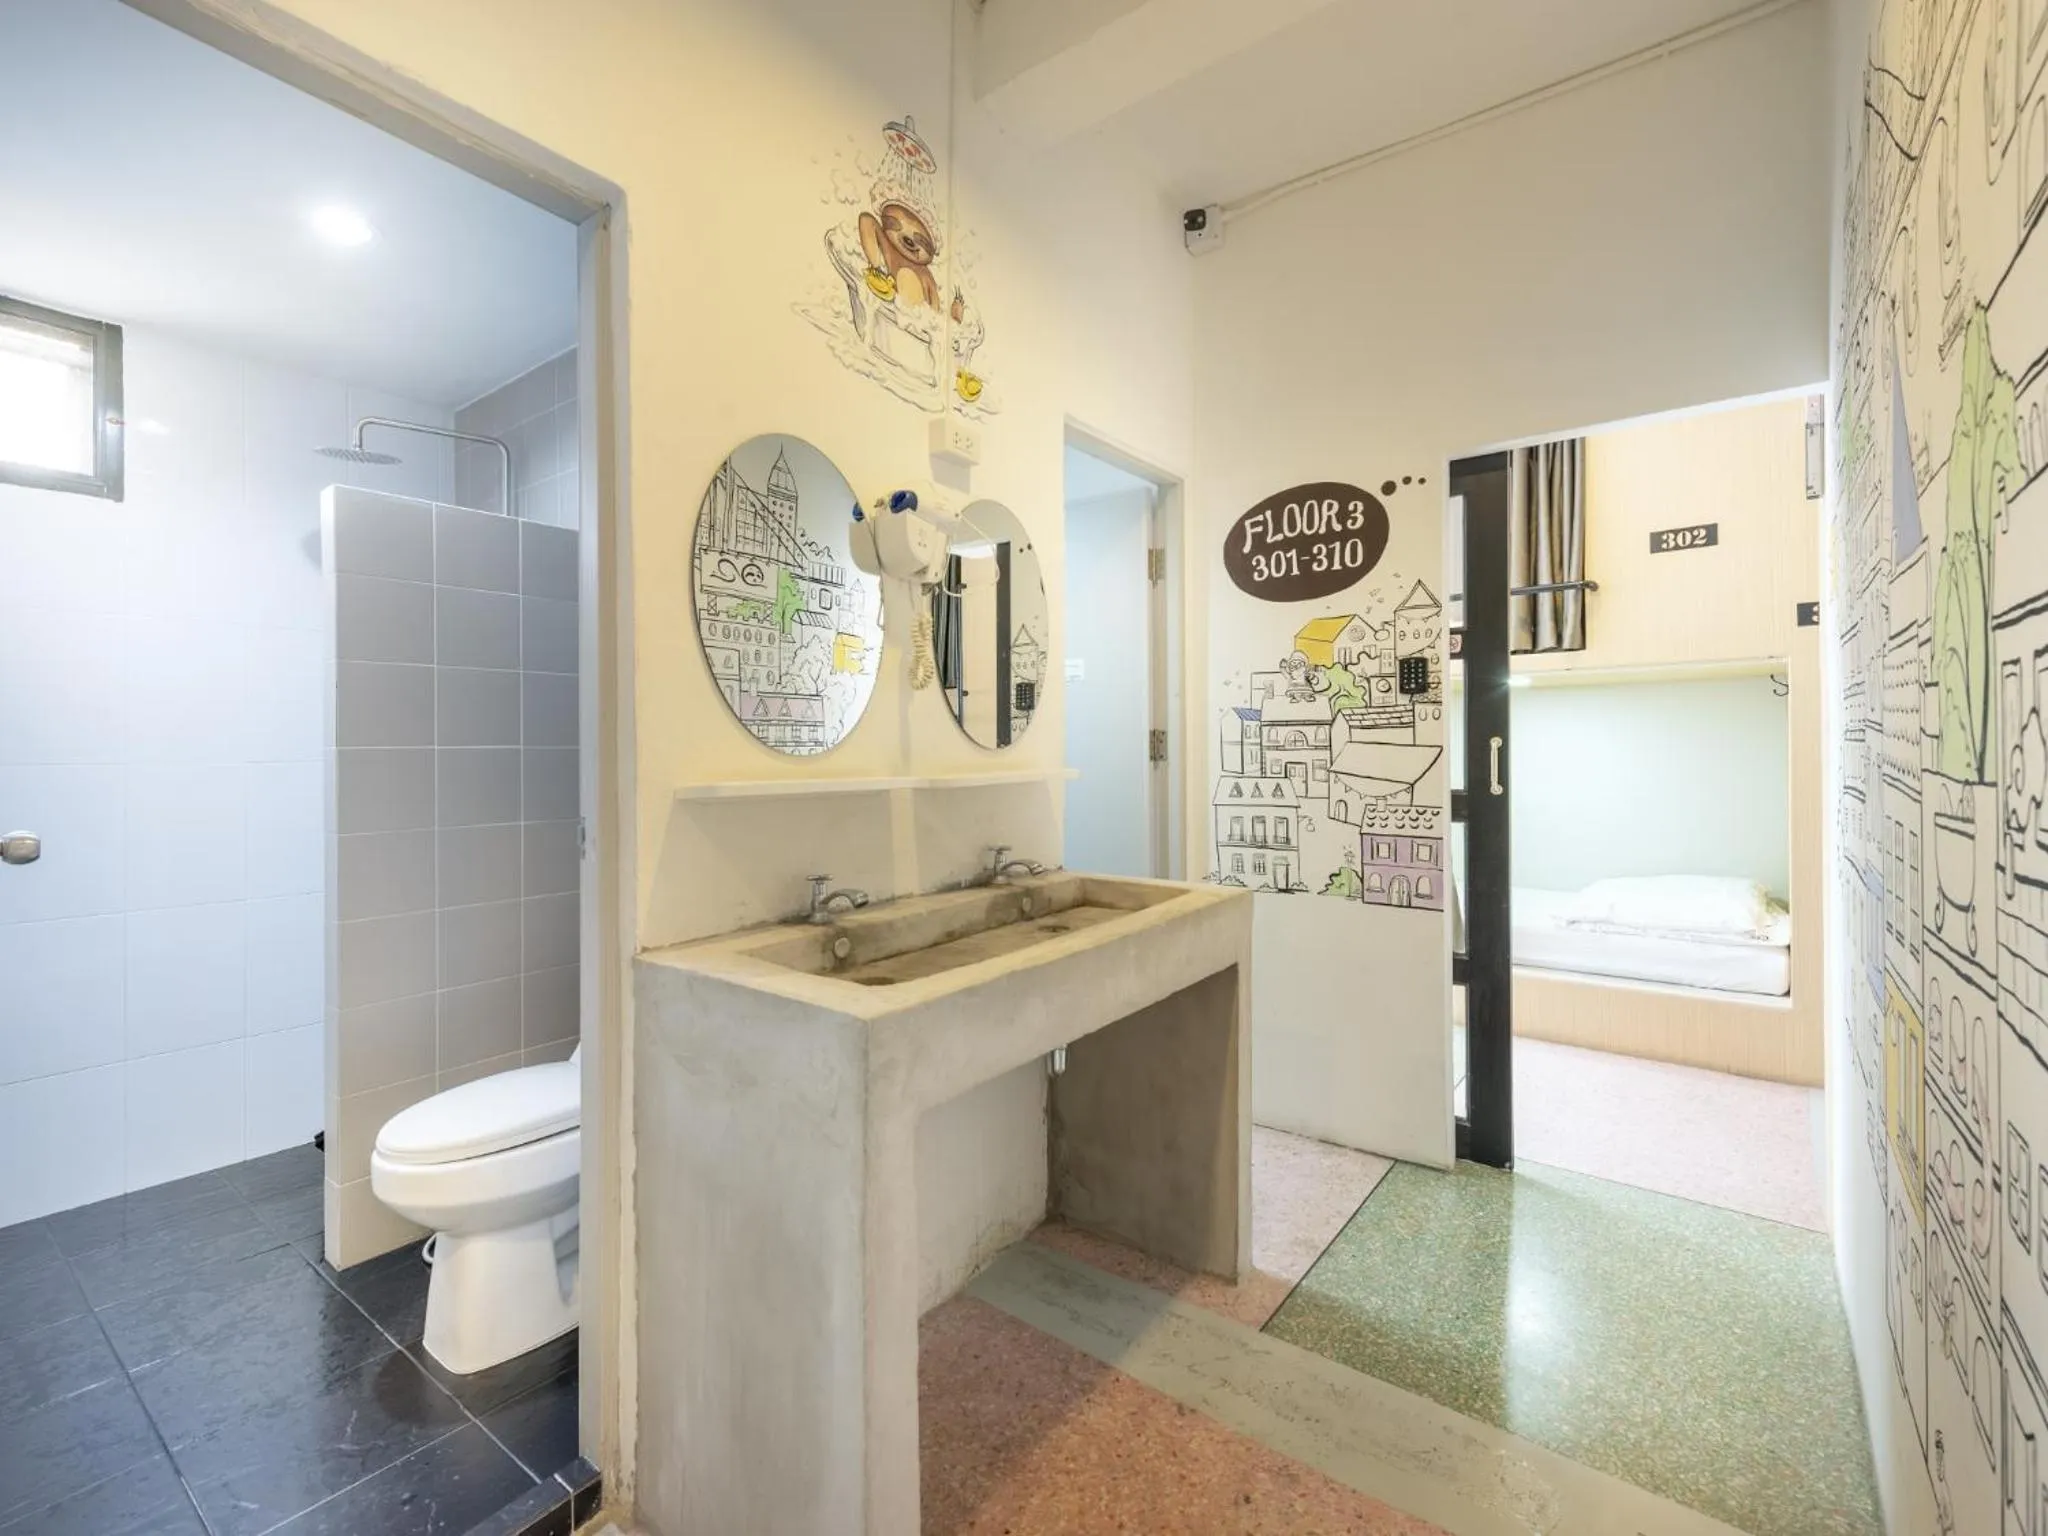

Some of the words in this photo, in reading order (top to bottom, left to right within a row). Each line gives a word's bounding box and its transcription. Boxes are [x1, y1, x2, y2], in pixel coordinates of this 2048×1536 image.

[1242, 499, 1343, 554] FLOOR
[1346, 500, 1365, 530] 3
[1661, 528, 1708, 549] 302
[1251, 538, 1364, 582] 301-310
